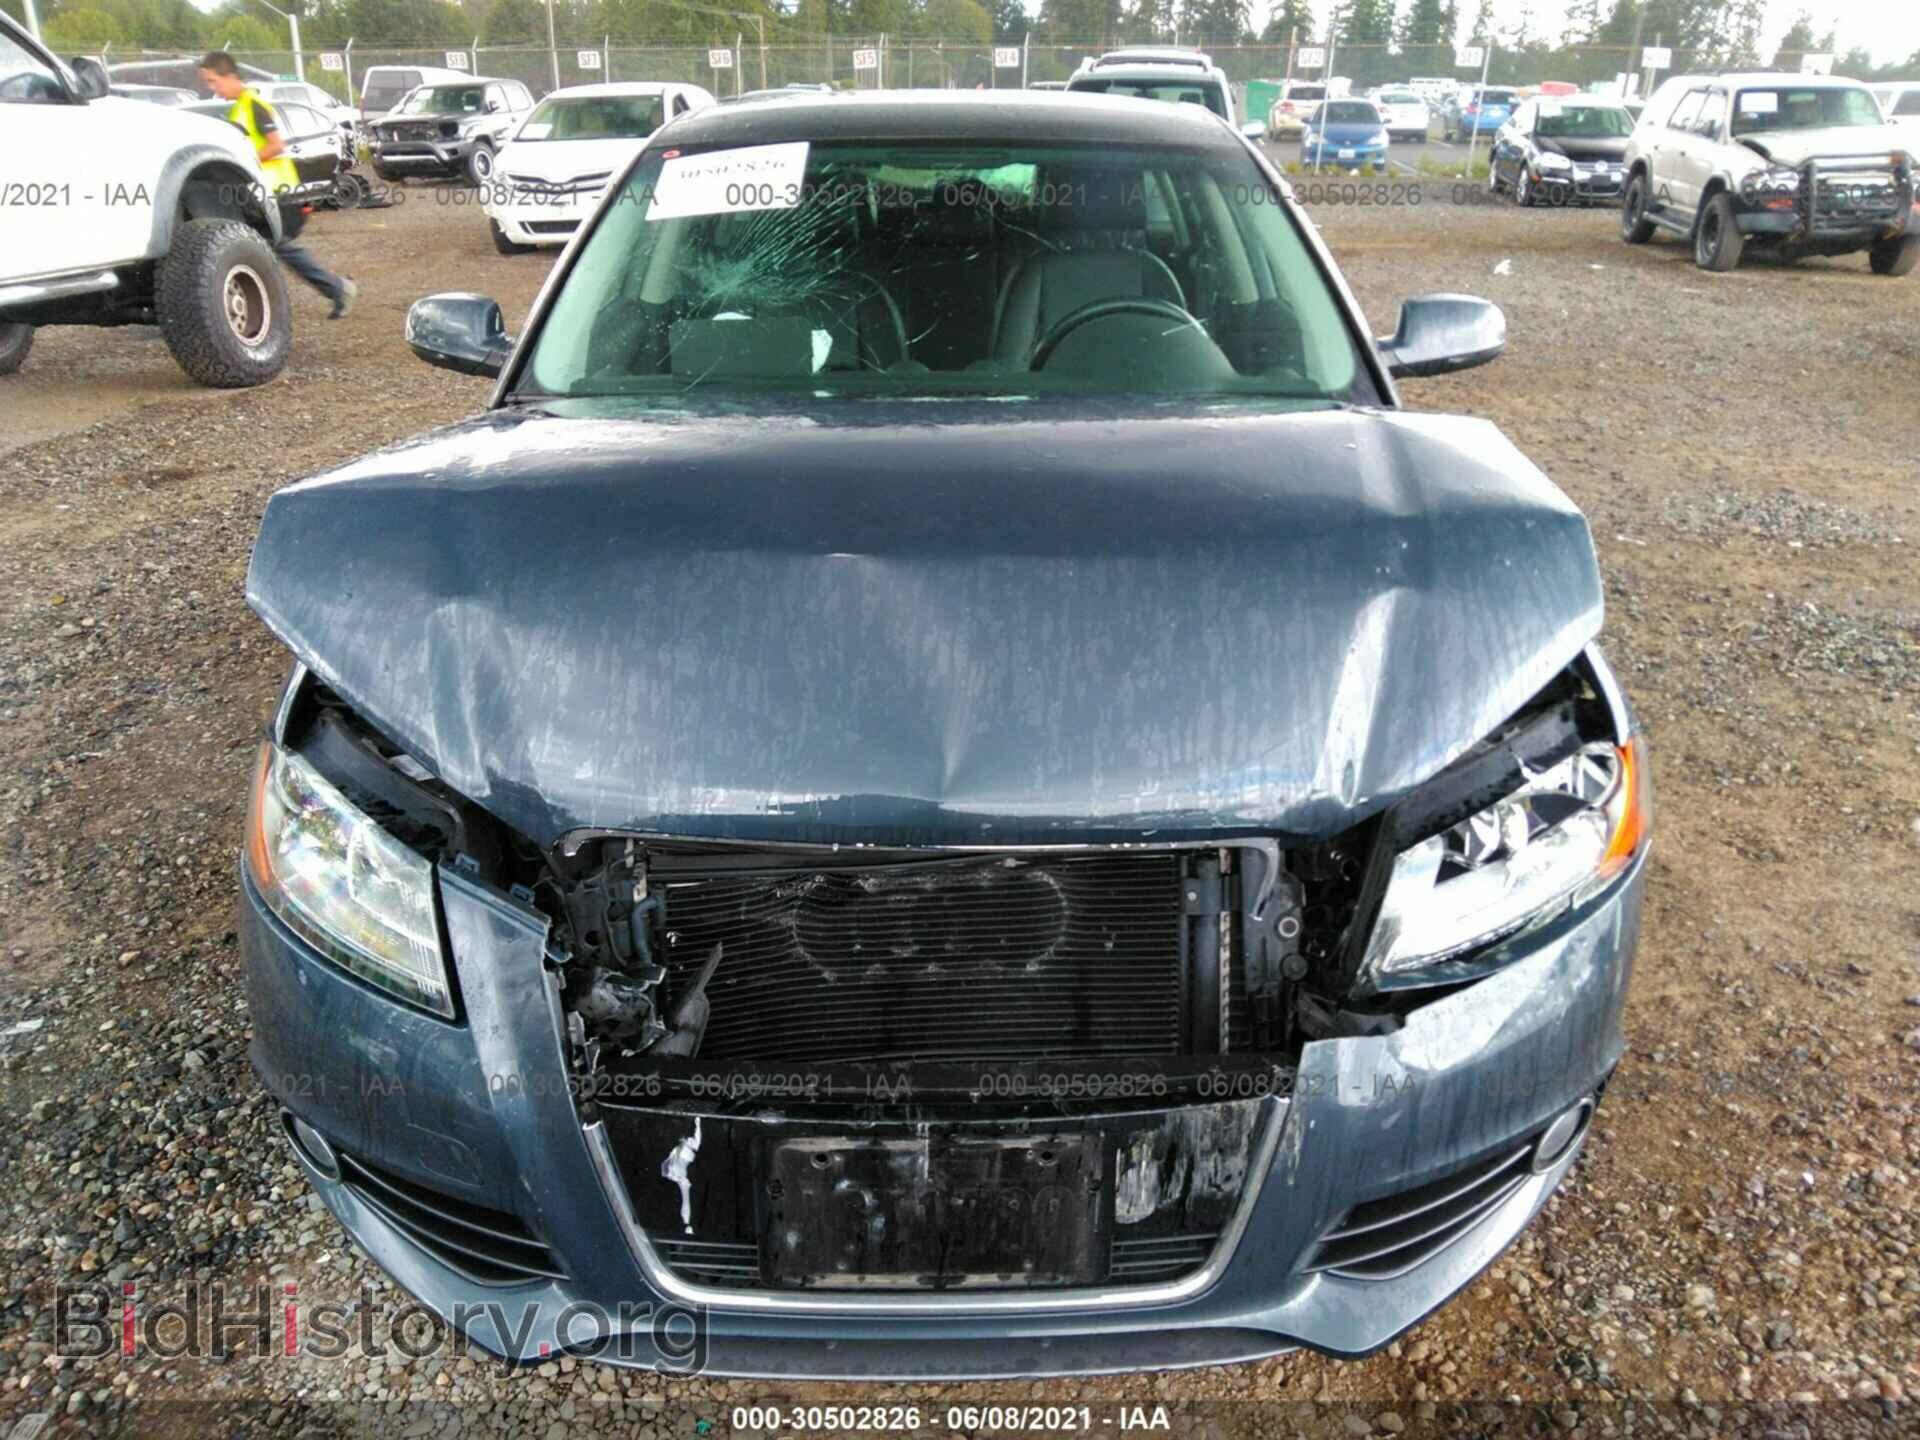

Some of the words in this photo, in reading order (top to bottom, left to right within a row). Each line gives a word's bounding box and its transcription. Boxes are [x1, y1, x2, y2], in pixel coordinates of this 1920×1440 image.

[448, 53, 467, 67] SF8
[580, 53, 598, 66] SF7
[711, 52, 731, 65] SF6
[855, 51, 875, 65] SF5
